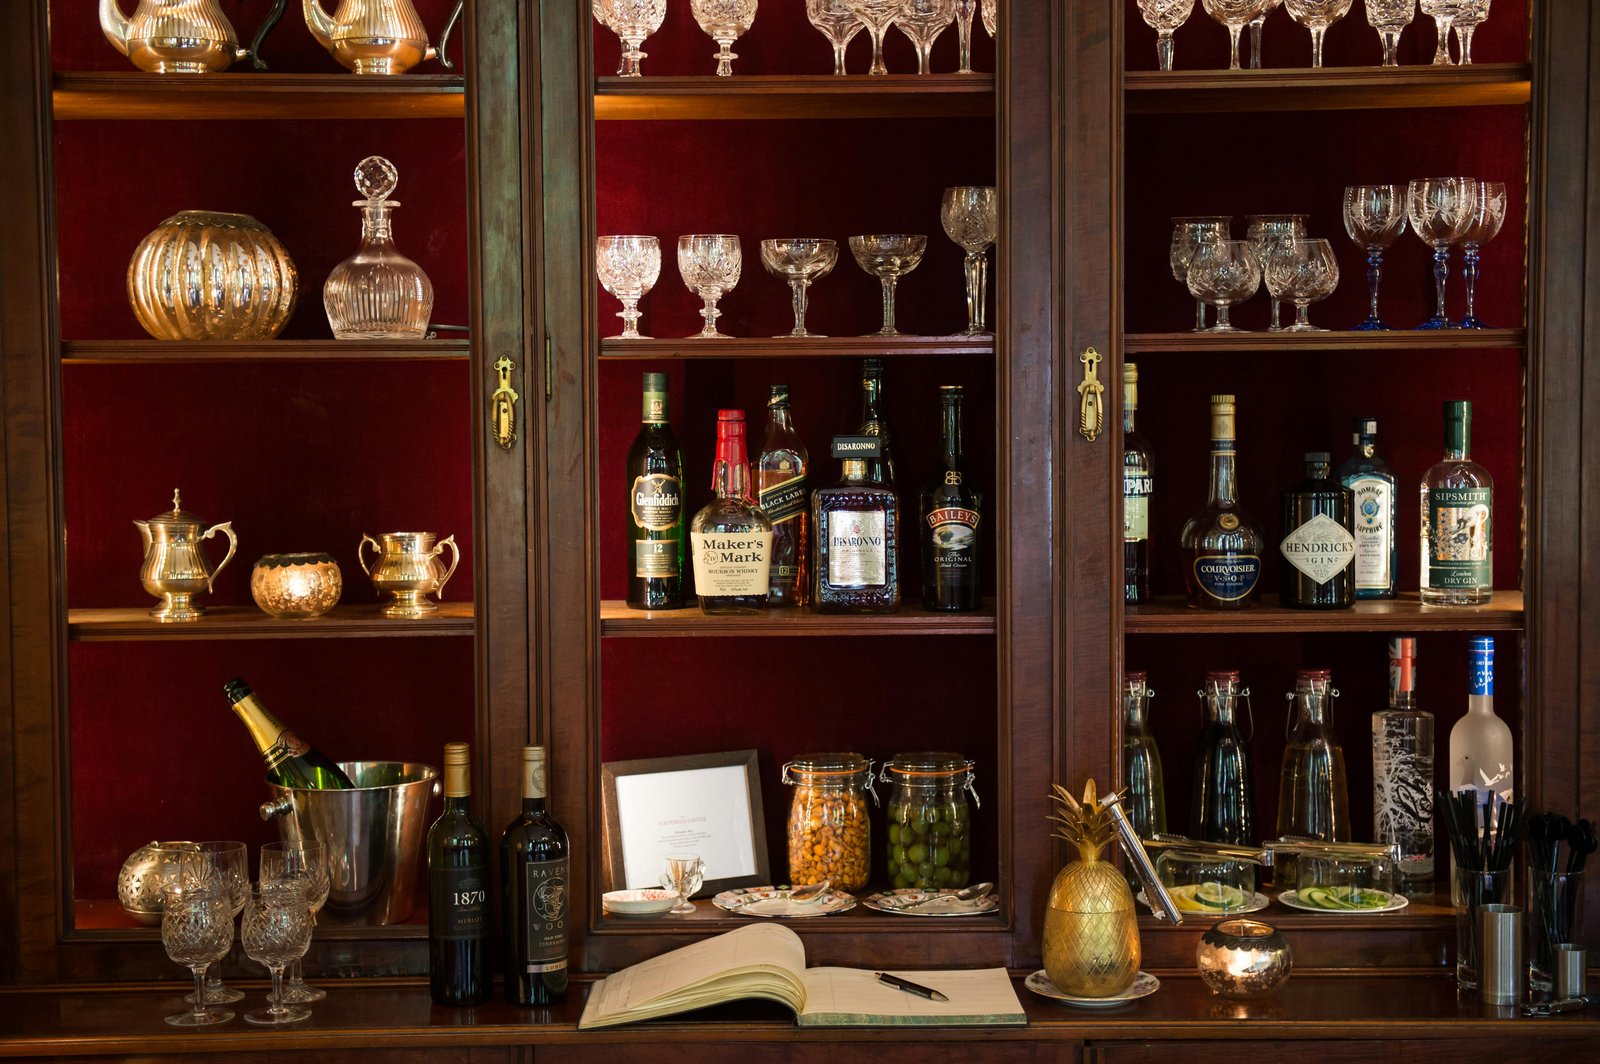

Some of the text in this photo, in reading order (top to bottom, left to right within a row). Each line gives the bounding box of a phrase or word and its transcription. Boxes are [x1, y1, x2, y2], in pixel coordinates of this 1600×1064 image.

[837, 442, 876, 451] DISARONNO
[1357, 486, 1383, 498] BOMBAY
[1435, 492, 1487, 501] SIPSMITH
[636, 492, 679, 506] Glenfiddich
[761, 497, 785, 510] BLACK
[929, 510, 977, 524] BAILEYS
[703, 539, 764, 550] Maker's
[833, 536, 881, 547] DISARONNO
[1286, 541, 1354, 552] HENDRICK'S
[653, 543, 663, 554] 12
[720, 552, 762, 563] Mark
[1200, 564, 1255, 575] COURVOISIER
[453, 890, 485, 906] 1870
